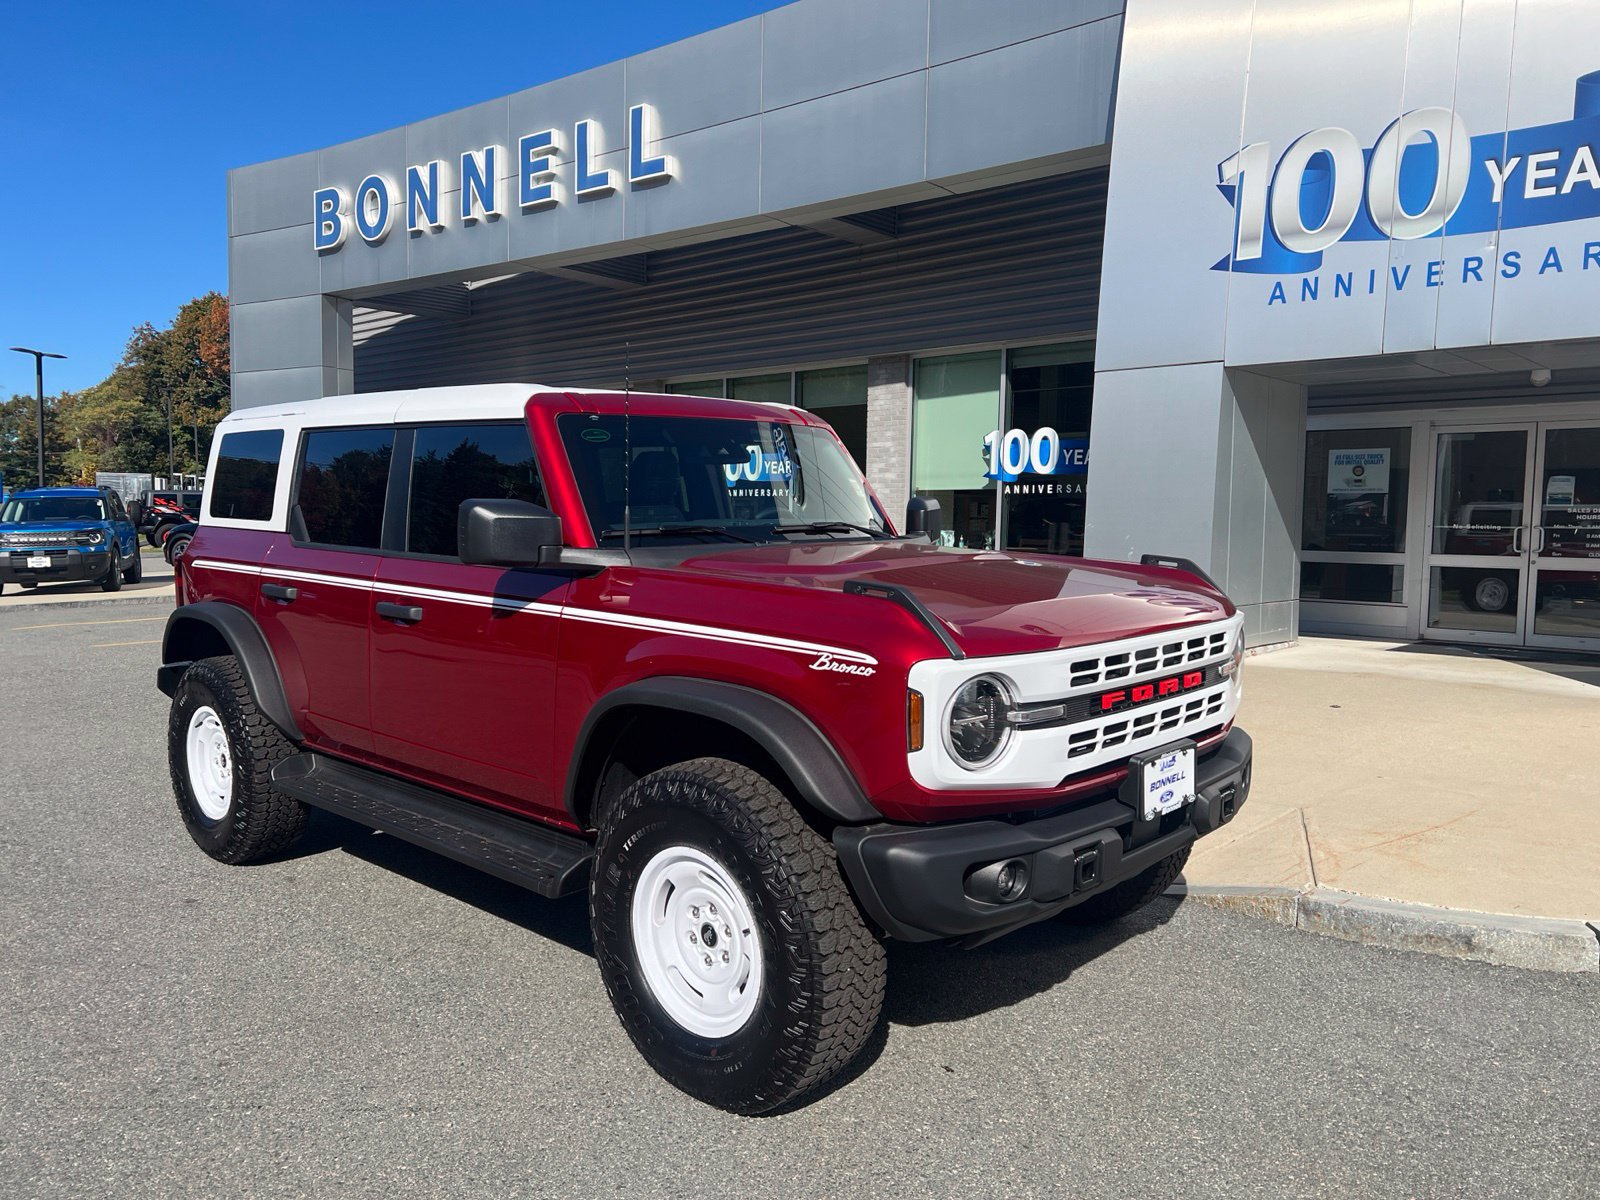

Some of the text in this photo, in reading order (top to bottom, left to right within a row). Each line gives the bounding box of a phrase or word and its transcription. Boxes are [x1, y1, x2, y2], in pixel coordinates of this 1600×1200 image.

[313, 103, 673, 250] BONNELL
[1216, 106, 1600, 261] 100 YEA
[1268, 241, 1600, 306] ANNIVERSAR
[983, 426, 1060, 475] 100
[1004, 484, 1087, 494] ANNIVERSA
[808, 652, 876, 676] Bronco
[1101, 671, 1202, 709] FORD
[1150, 770, 1186, 792] BONNELL
